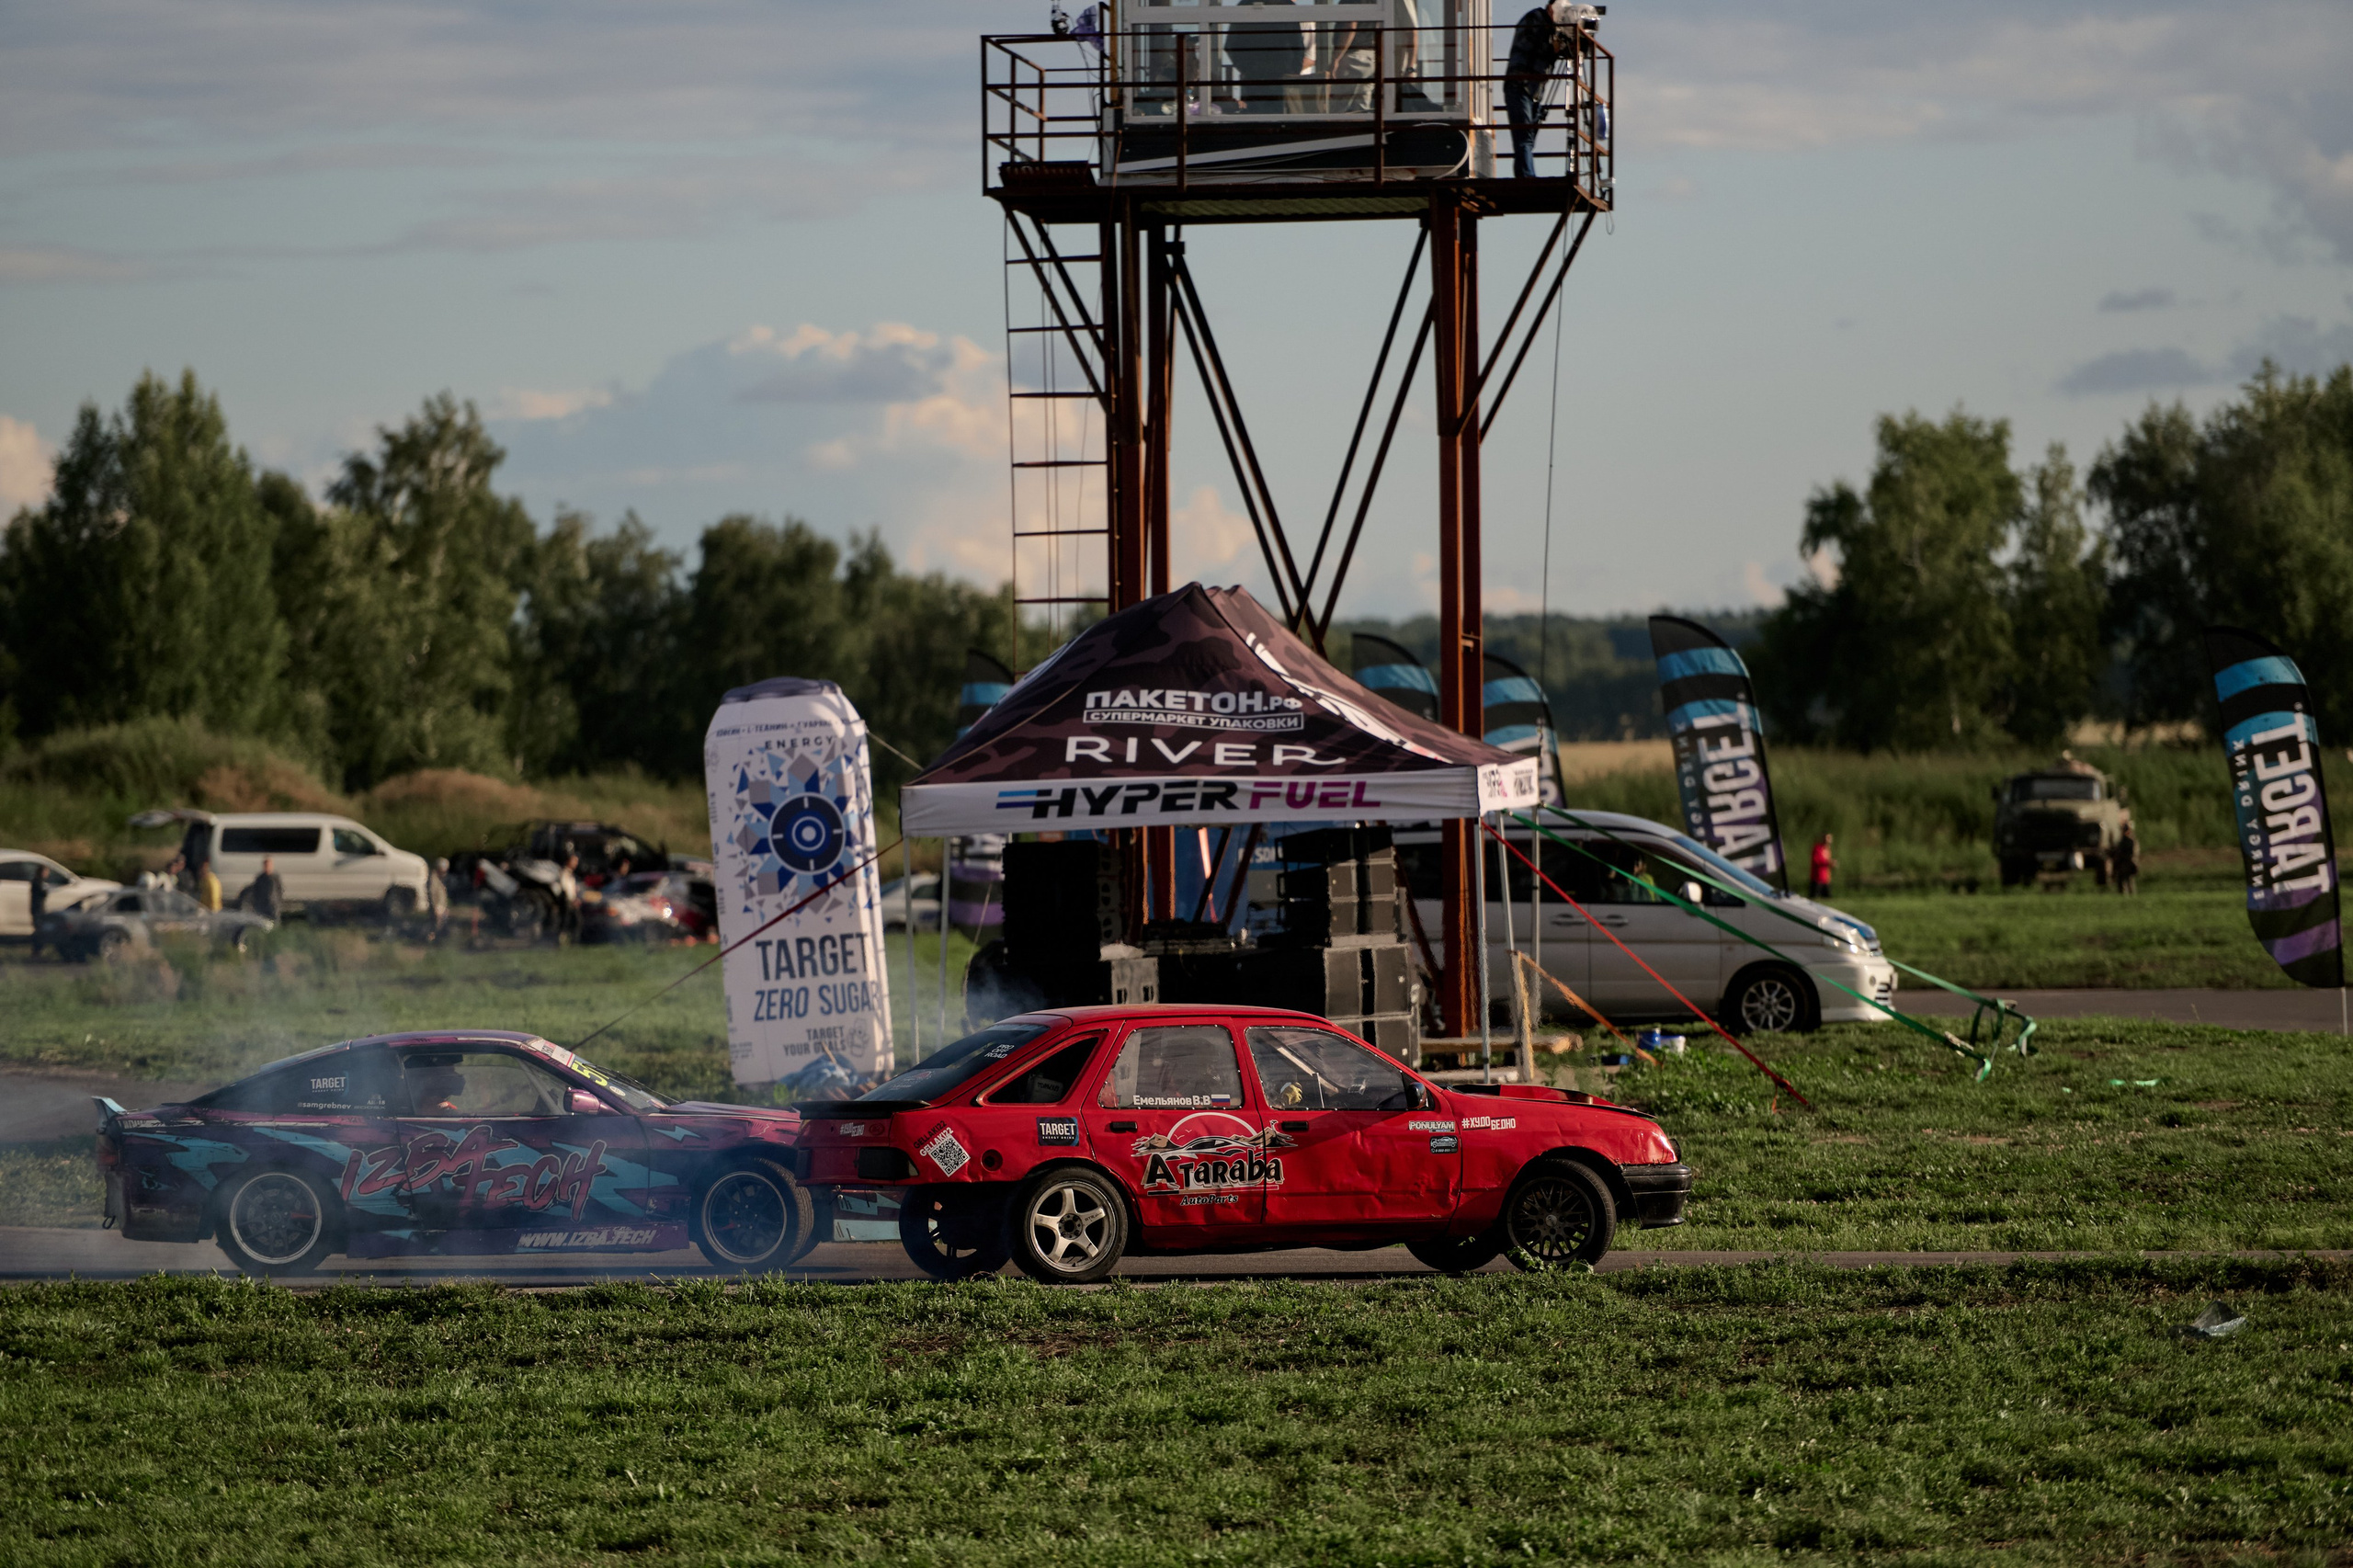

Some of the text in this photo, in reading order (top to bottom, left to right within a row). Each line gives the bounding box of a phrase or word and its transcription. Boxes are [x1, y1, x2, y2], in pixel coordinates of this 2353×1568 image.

[1090, 711, 1299, 730] СУПЕРМАРКЕТ УПАКОВКИ
[765, 736, 834, 750] ENERGY
[1065, 735, 1347, 766] RIVER
[1030, 779, 1381, 819] HYPER FUEL
[755, 932, 868, 982] TARGET
[754, 986, 809, 1022] ZERO
[806, 1026, 844, 1040] TARGET
[783, 1041, 811, 1056] YOUR
[311, 1076, 347, 1090] TARGET
[1132, 1095, 1192, 1106] Емельянов
[1040, 1122, 1076, 1136] TARGET
[1408, 1120, 1455, 1131] PONULYAM
[913, 1120, 947, 1149] GELLAKI22
[919, 1127, 954, 1156] GELLAKI22
[1180, 1194, 1239, 1206] AutoParts
